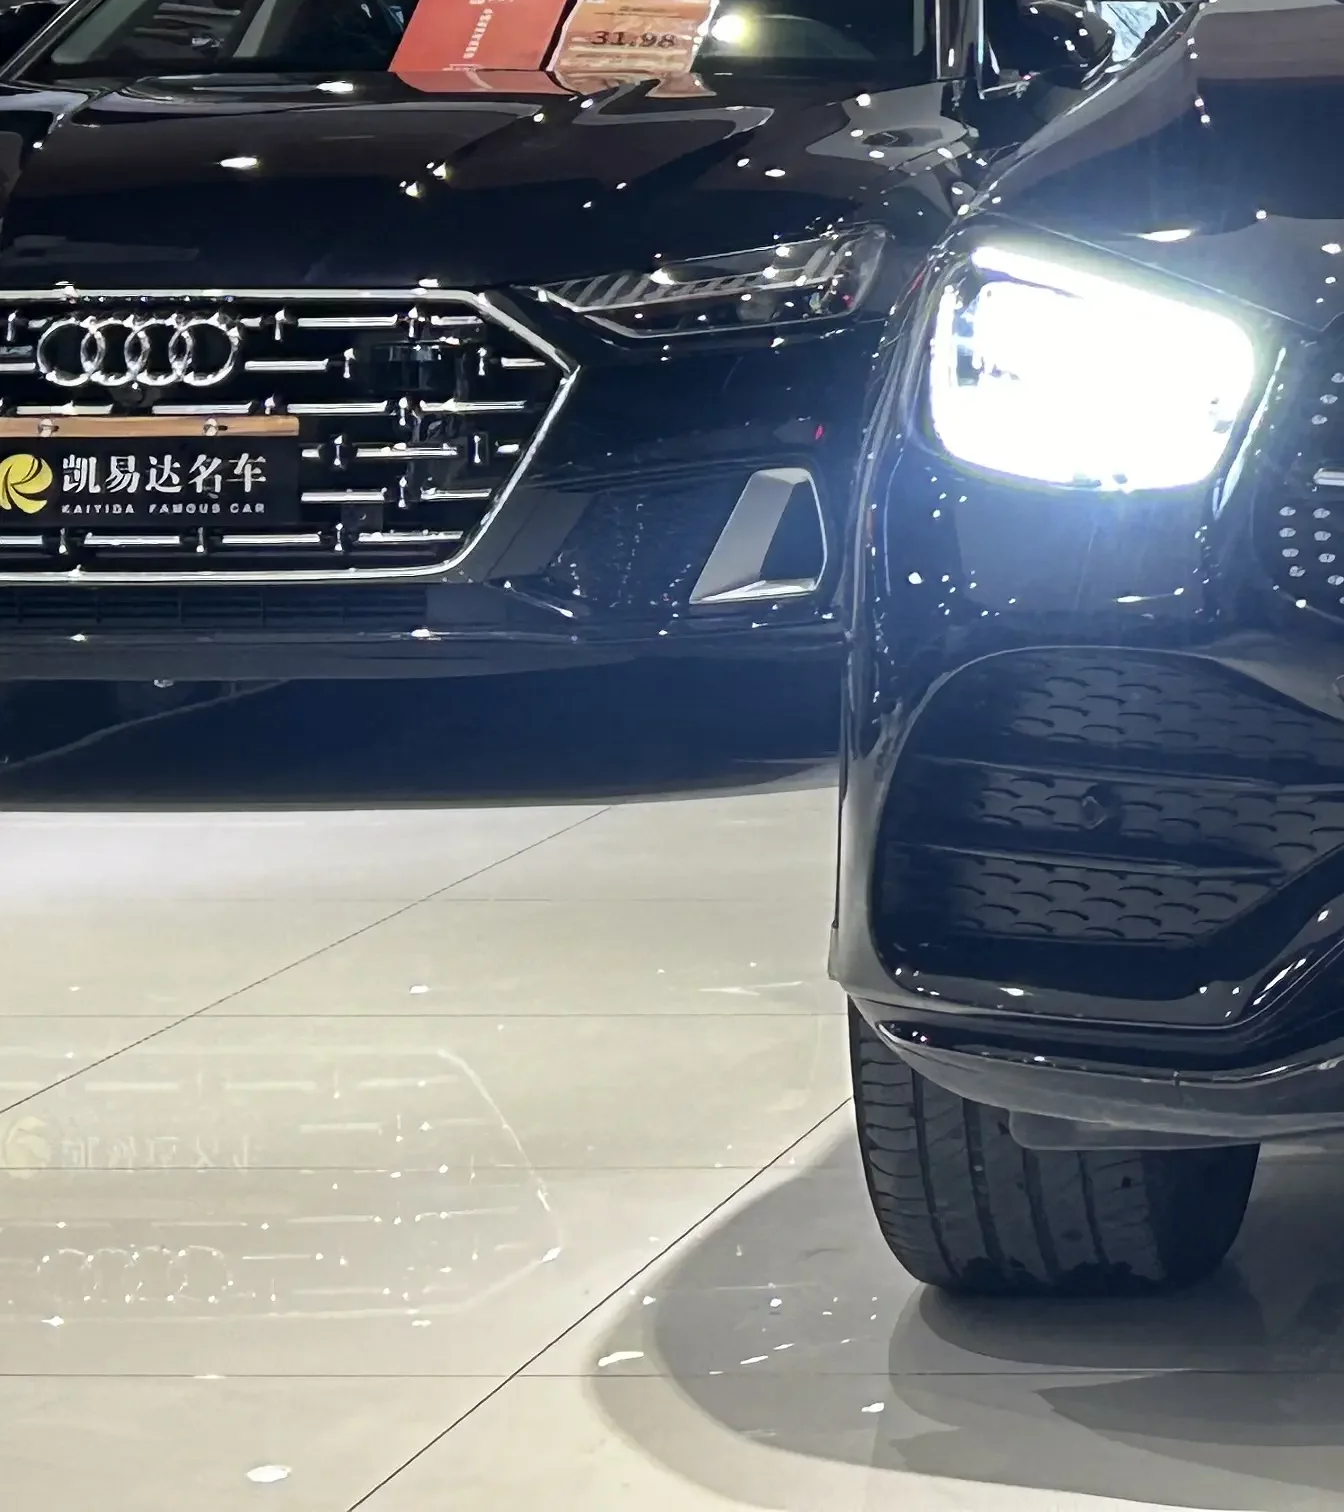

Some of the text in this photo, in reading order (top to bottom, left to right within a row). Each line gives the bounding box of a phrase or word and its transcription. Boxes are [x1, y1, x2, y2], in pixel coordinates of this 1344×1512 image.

[61, 452, 268, 494] 凯易达名车
[229, 503, 266, 514] CAR
